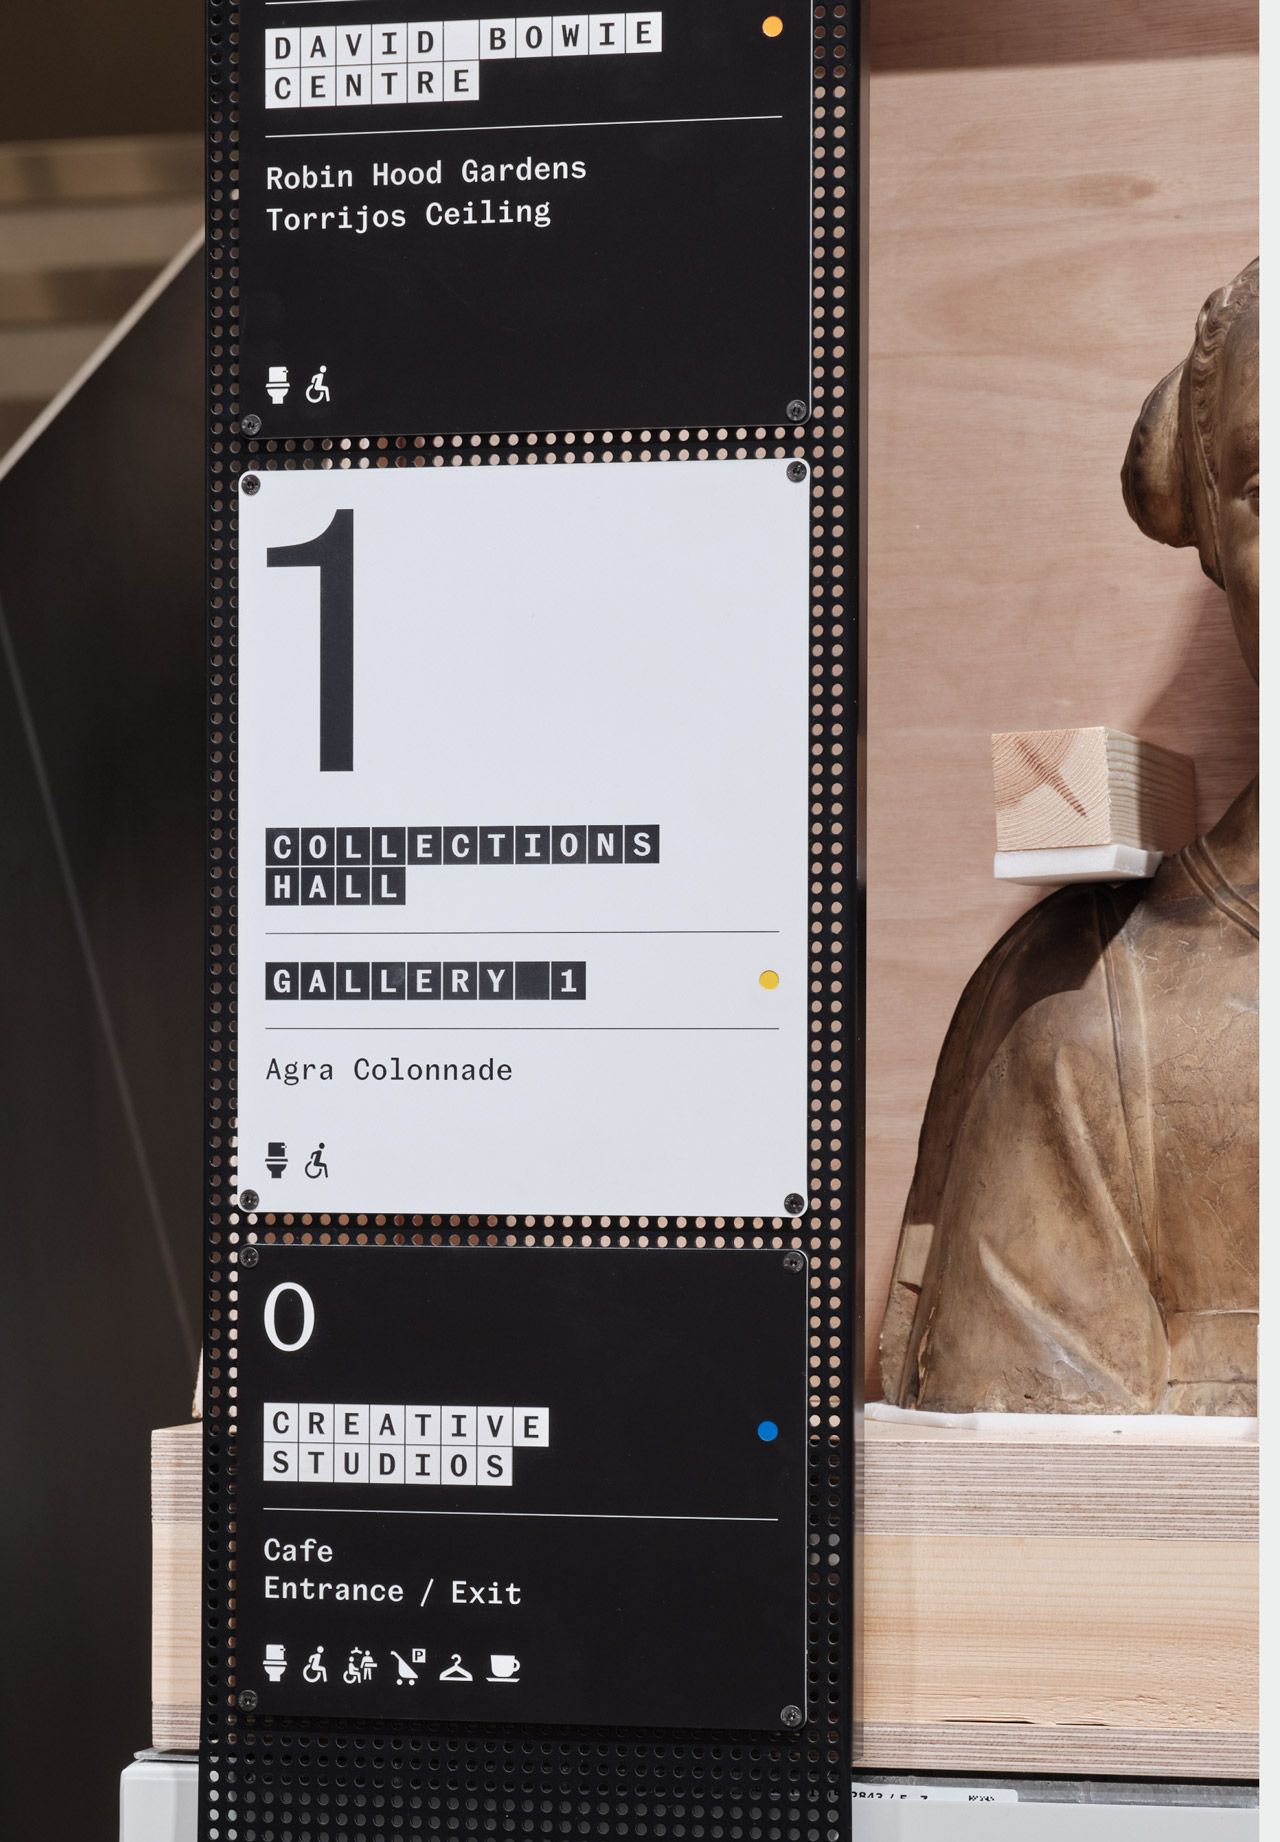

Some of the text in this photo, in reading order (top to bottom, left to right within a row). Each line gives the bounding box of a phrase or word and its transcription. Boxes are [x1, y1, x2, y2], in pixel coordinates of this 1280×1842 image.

[274, 20, 652, 60] DAVID BOWIE
[274, 69, 470, 100] CENTRE
[267, 156, 587, 190] Robin Hood Gardens
[266, 199, 551, 234] Torrijos Ceiling
[266, 508, 354, 772] 1
[273, 831, 653, 860] COLLECTIONS
[273, 873, 397, 899] HALL
[273, 968, 578, 995] GALLERY 1
[265, 1057, 512, 1086] Agra Colonnade
[263, 1281, 315, 1352] 0
[272, 1410, 540, 1439] CREATIVE
[272, 1450, 504, 1478] STUDIOS
[264, 1537, 333, 1563] Cafe
[265, 1575, 521, 1607] Entrance / Exit
